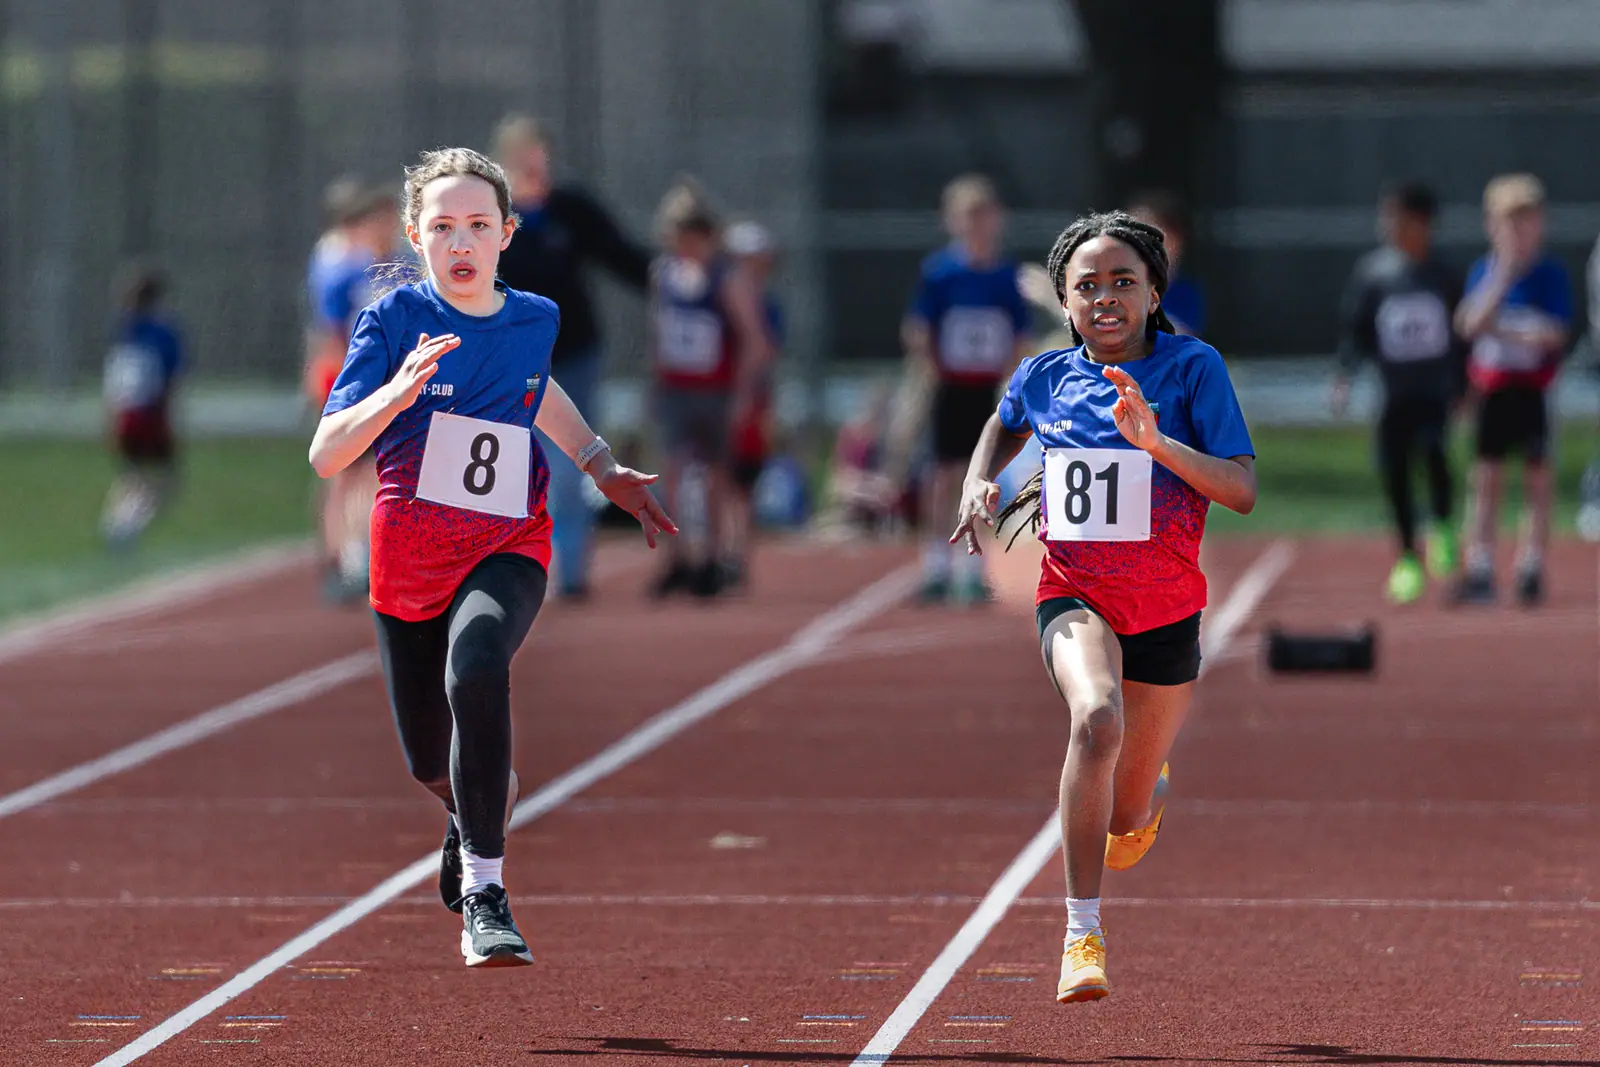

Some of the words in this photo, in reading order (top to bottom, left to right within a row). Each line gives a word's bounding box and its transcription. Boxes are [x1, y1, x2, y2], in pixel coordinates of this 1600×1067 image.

[420, 383, 454, 396] Y-CLUB
[462, 432, 500, 496] 8
[1064, 460, 1120, 525] 81
